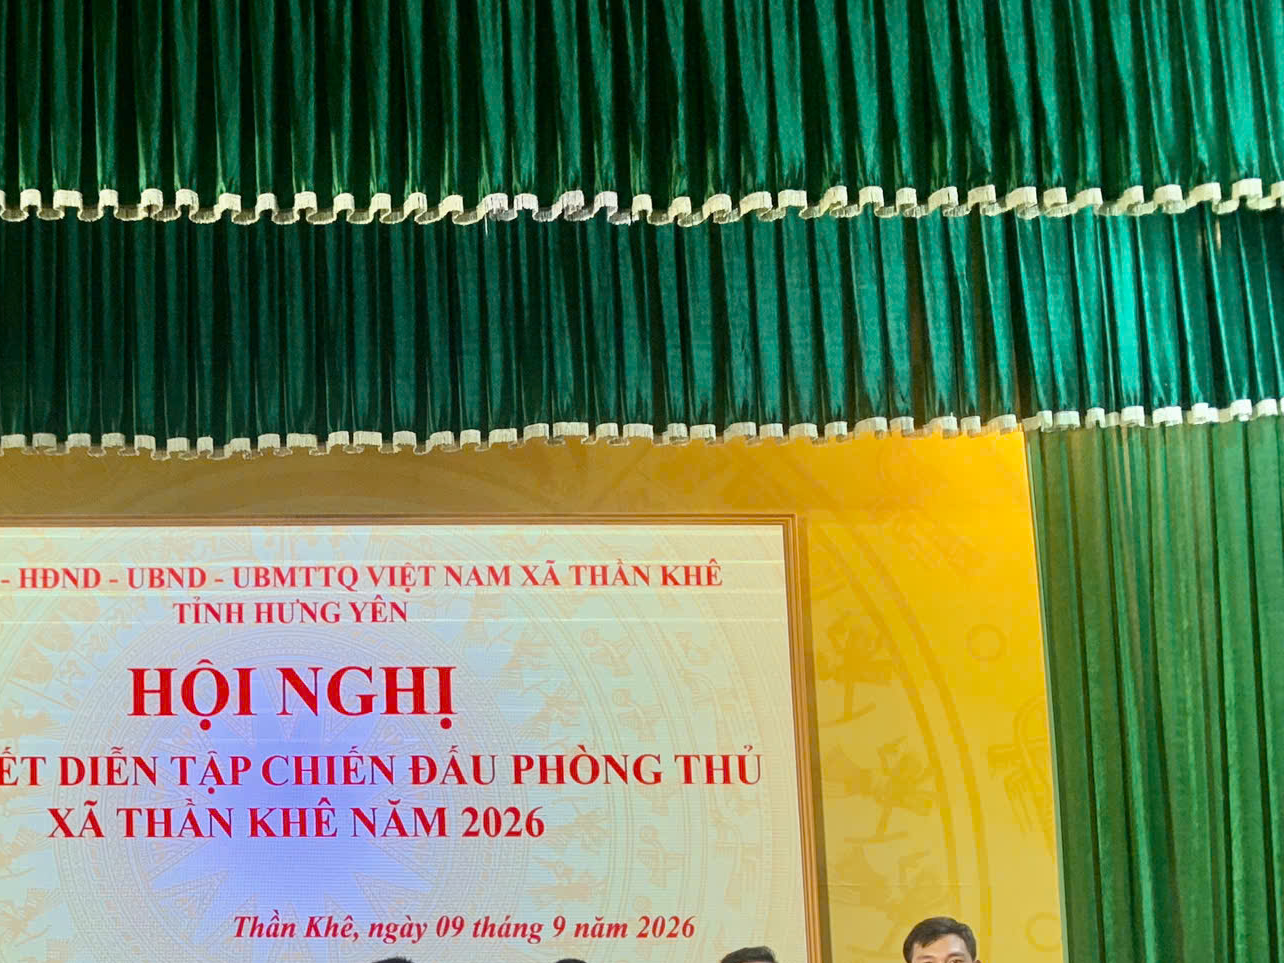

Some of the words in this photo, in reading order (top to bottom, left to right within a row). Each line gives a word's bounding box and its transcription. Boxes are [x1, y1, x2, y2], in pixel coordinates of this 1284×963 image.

[19, 567, 102, 590] HĐND
[127, 567, 207, 590] UBND
[233, 566, 359, 592] UBMTTQ
[366, 562, 436, 593] VIỆT
[443, 564, 511, 587] NAM
[520, 560, 561, 587] XÃ
[569, 559, 651, 587] THẦN
[660, 558, 723, 587] KHÊ
[173, 596, 245, 625] TỈNH
[255, 599, 342, 624] HƯNG
[349, 594, 409, 624] YÊN
[127, 658, 256, 732] HỘI
[275, 665, 457, 730] NGHỊ
[59, 746, 158, 787] DIỄN
[170, 750, 252, 795] TẬP
[261, 745, 396, 787] CHIẾN
[408, 745, 499, 786] ĐẤU
[512, 744, 663, 786] PHÒNG
[674, 744, 764, 786] THỦ
[47, 799, 105, 839] XÃ
[116, 797, 234, 839] THẦN
[247, 796, 338, 839] KHÊ
[349, 798, 449, 838] NĂM
[461, 806, 545, 839] 2026
[233, 909, 297, 939] Thần
[303, 914, 360, 942] Khê,
[367, 915, 428, 944] ngày
[435, 916, 466, 939] 09
[472, 915, 544, 944] tháng
[552, 916, 567, 938] 9
[573, 917, 629, 939] năm
[636, 915, 696, 939] 2026
